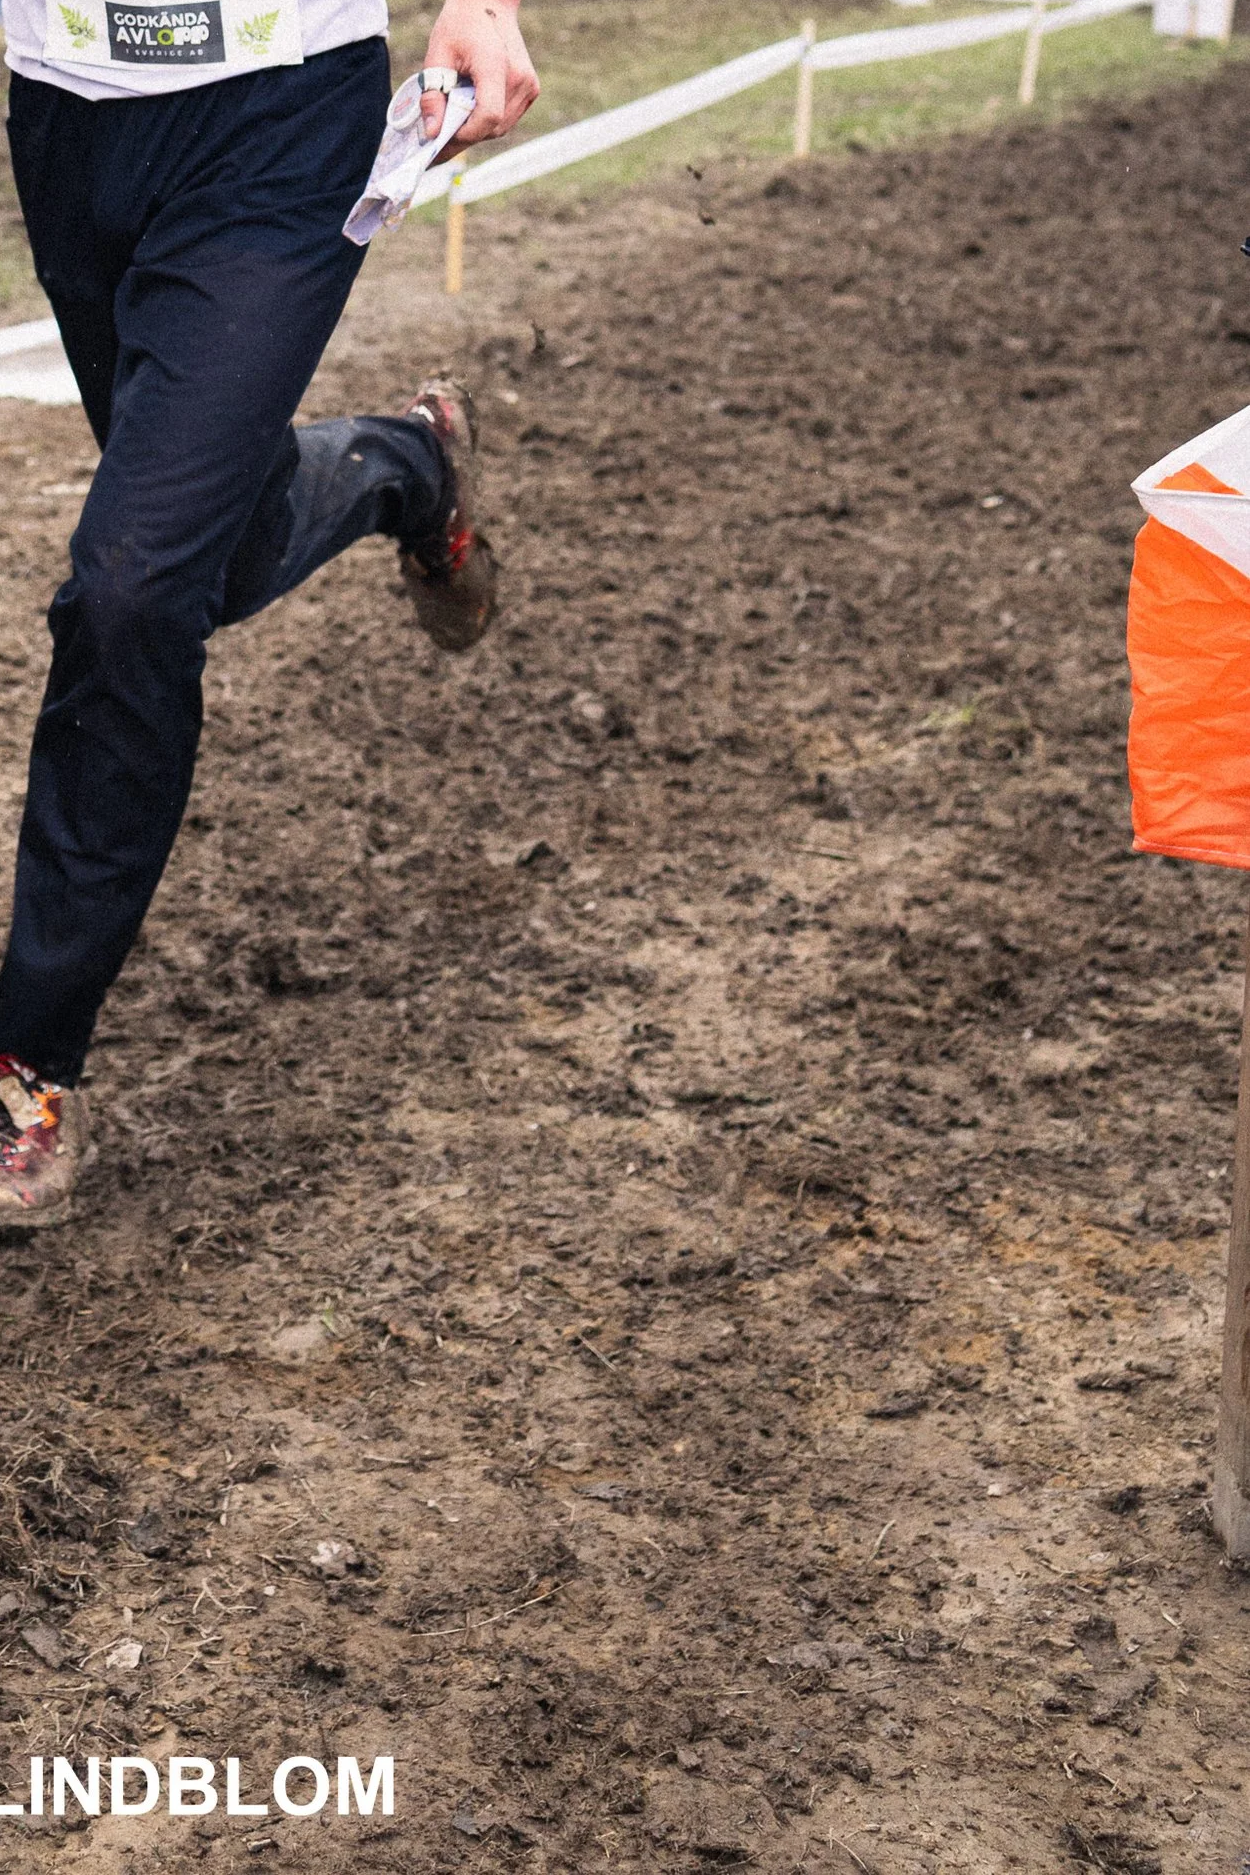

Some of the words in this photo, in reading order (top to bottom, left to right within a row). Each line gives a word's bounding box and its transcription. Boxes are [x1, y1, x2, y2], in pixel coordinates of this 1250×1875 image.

[113, 11, 210, 28] GODKÄNDA
[116, 26, 210, 46] AVLOPP
[135, 48, 183, 56] SVERIGE
